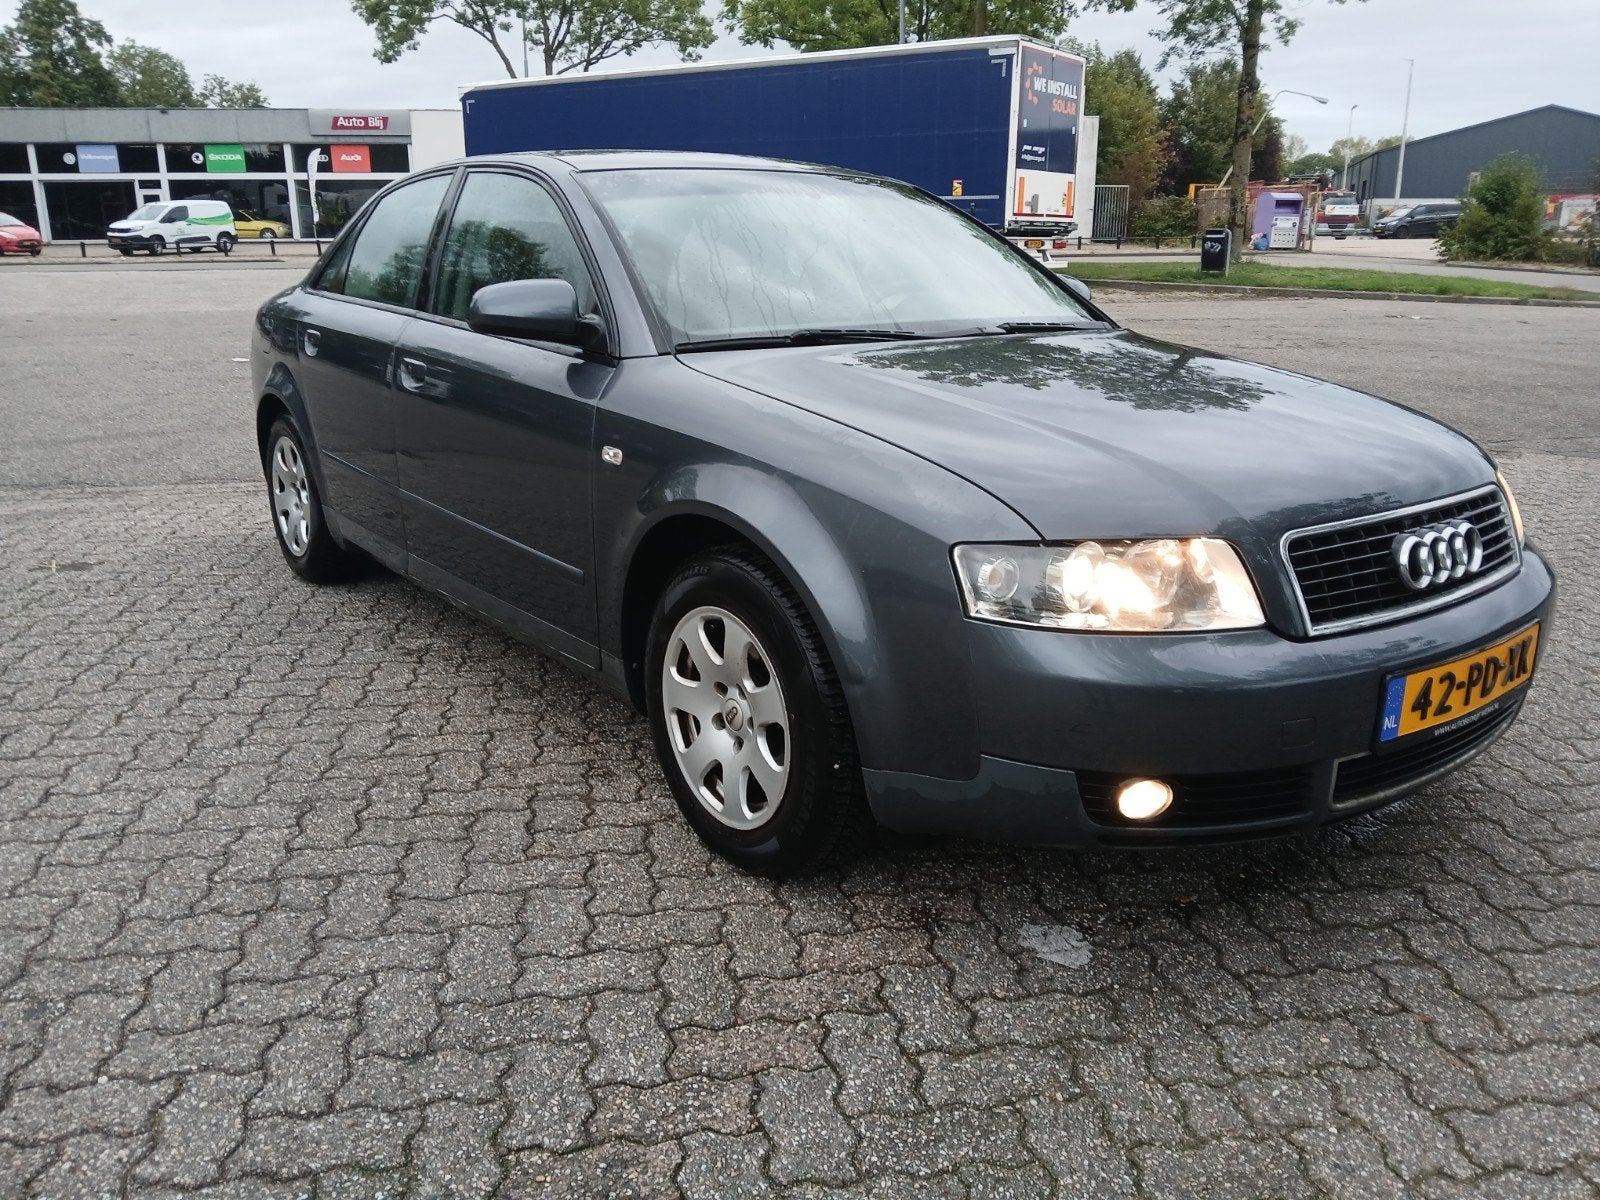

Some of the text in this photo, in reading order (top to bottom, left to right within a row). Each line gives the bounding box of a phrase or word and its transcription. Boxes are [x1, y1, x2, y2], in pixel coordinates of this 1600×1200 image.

[1033, 76, 1078, 99] WE INSTALL
[1052, 98, 1077, 115] SOLAR
[337, 116, 384, 130] Auto Blij
[340, 153, 362, 161] Audi
[1410, 635, 1533, 721] 42-PD-XK
[1383, 715, 1398, 730] NL
